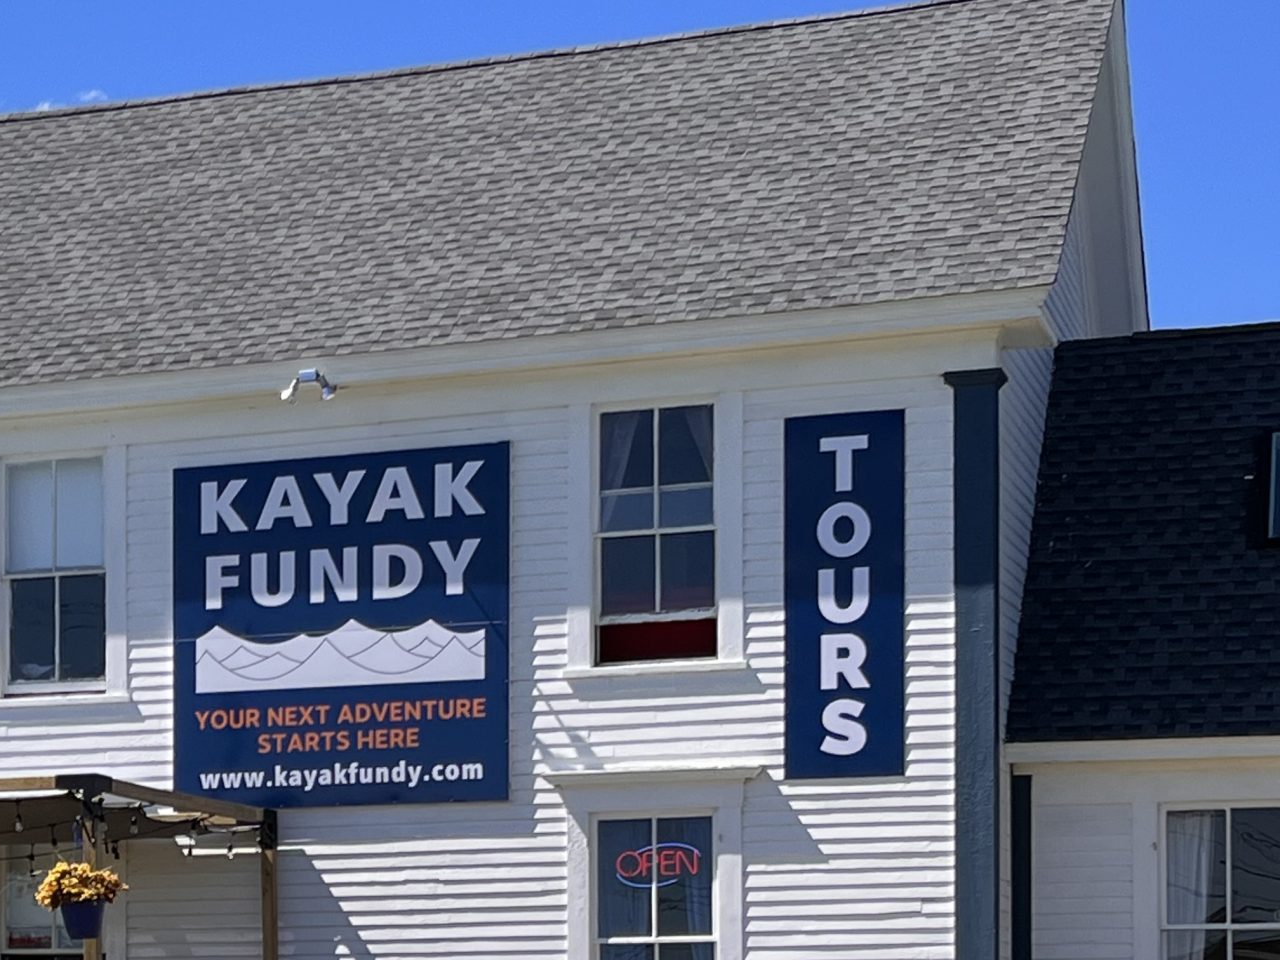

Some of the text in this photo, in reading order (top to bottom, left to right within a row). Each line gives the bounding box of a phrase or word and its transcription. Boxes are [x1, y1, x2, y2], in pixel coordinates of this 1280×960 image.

[200, 459, 486, 535] KAYAK
[205, 537, 482, 611] FUNDY
[817, 433, 871, 756] TOURS
[195, 697, 487, 731] YOUR NEXT ADVENTURE
[257, 727, 420, 754] STARTS HERE
[199, 759, 484, 791] www.kayakfundy.com
[616, 850, 699, 878] OPEN
